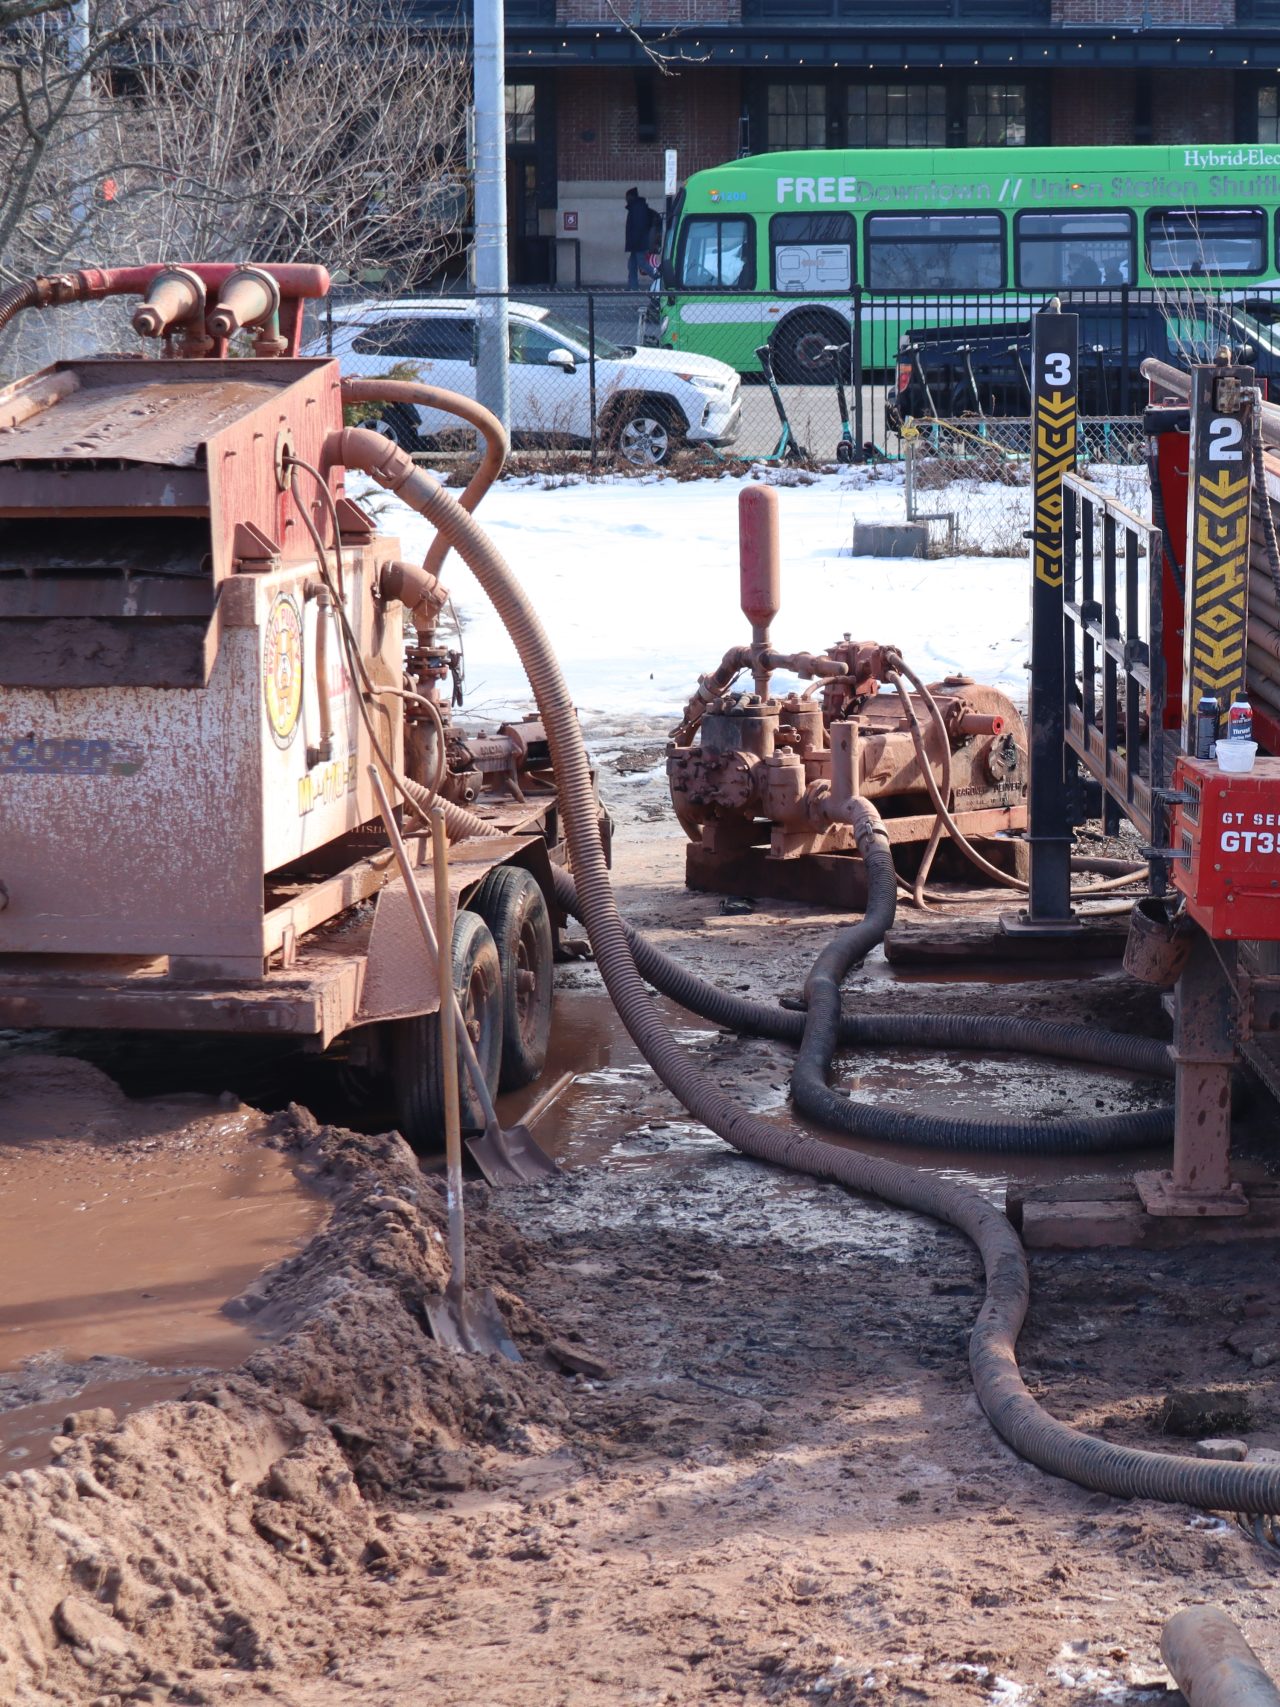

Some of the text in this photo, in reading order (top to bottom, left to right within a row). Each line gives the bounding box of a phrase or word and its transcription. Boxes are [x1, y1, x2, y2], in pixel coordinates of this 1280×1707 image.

[776, 177, 857, 203] FREE
[857, 180, 991, 202] Downtown
[1030, 178, 1103, 200] Union
[1111, 176, 1199, 199] Station
[1044, 352, 1072, 386] 3
[1208, 417, 1243, 461] 2
[1222, 812, 1245, 825] GT
